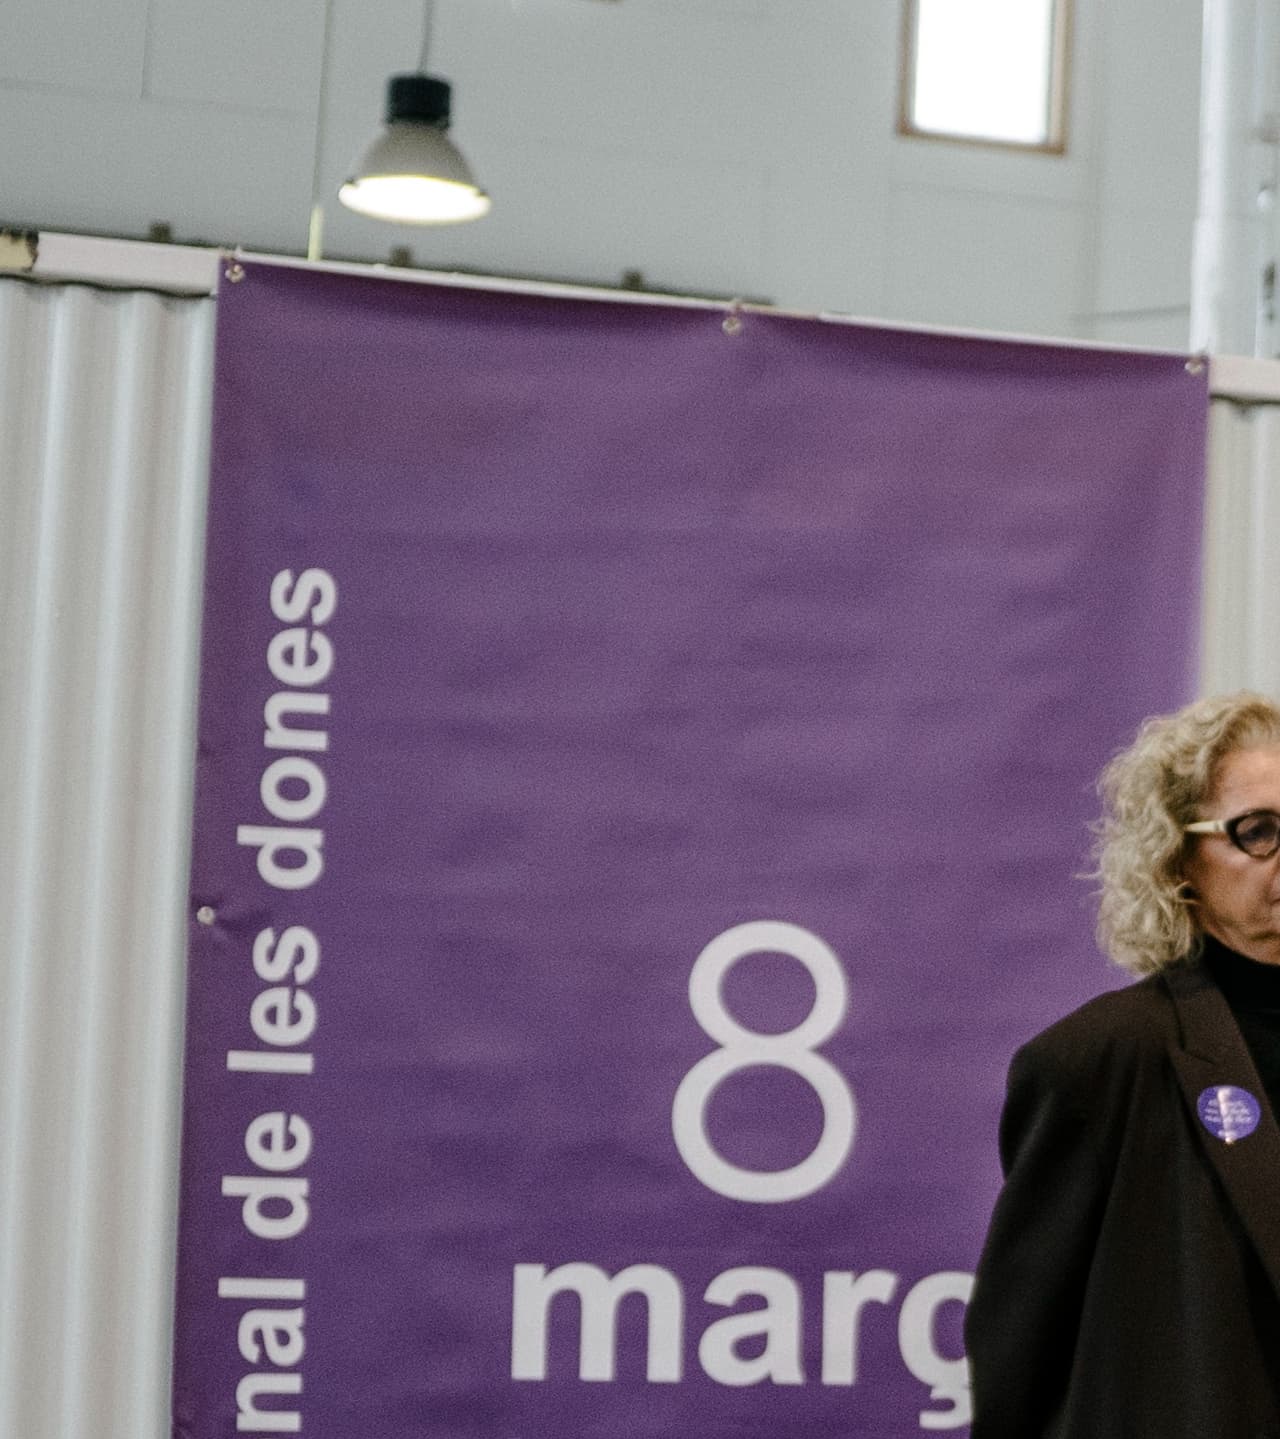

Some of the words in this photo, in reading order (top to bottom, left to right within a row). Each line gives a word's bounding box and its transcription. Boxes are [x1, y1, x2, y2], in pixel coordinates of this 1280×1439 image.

[236, 567, 338, 890] dones
[226, 925, 320, 1074] les
[670, 919, 857, 1204] 8
[220, 1111, 313, 1240] de
[510, 1261, 977, 1430] març
